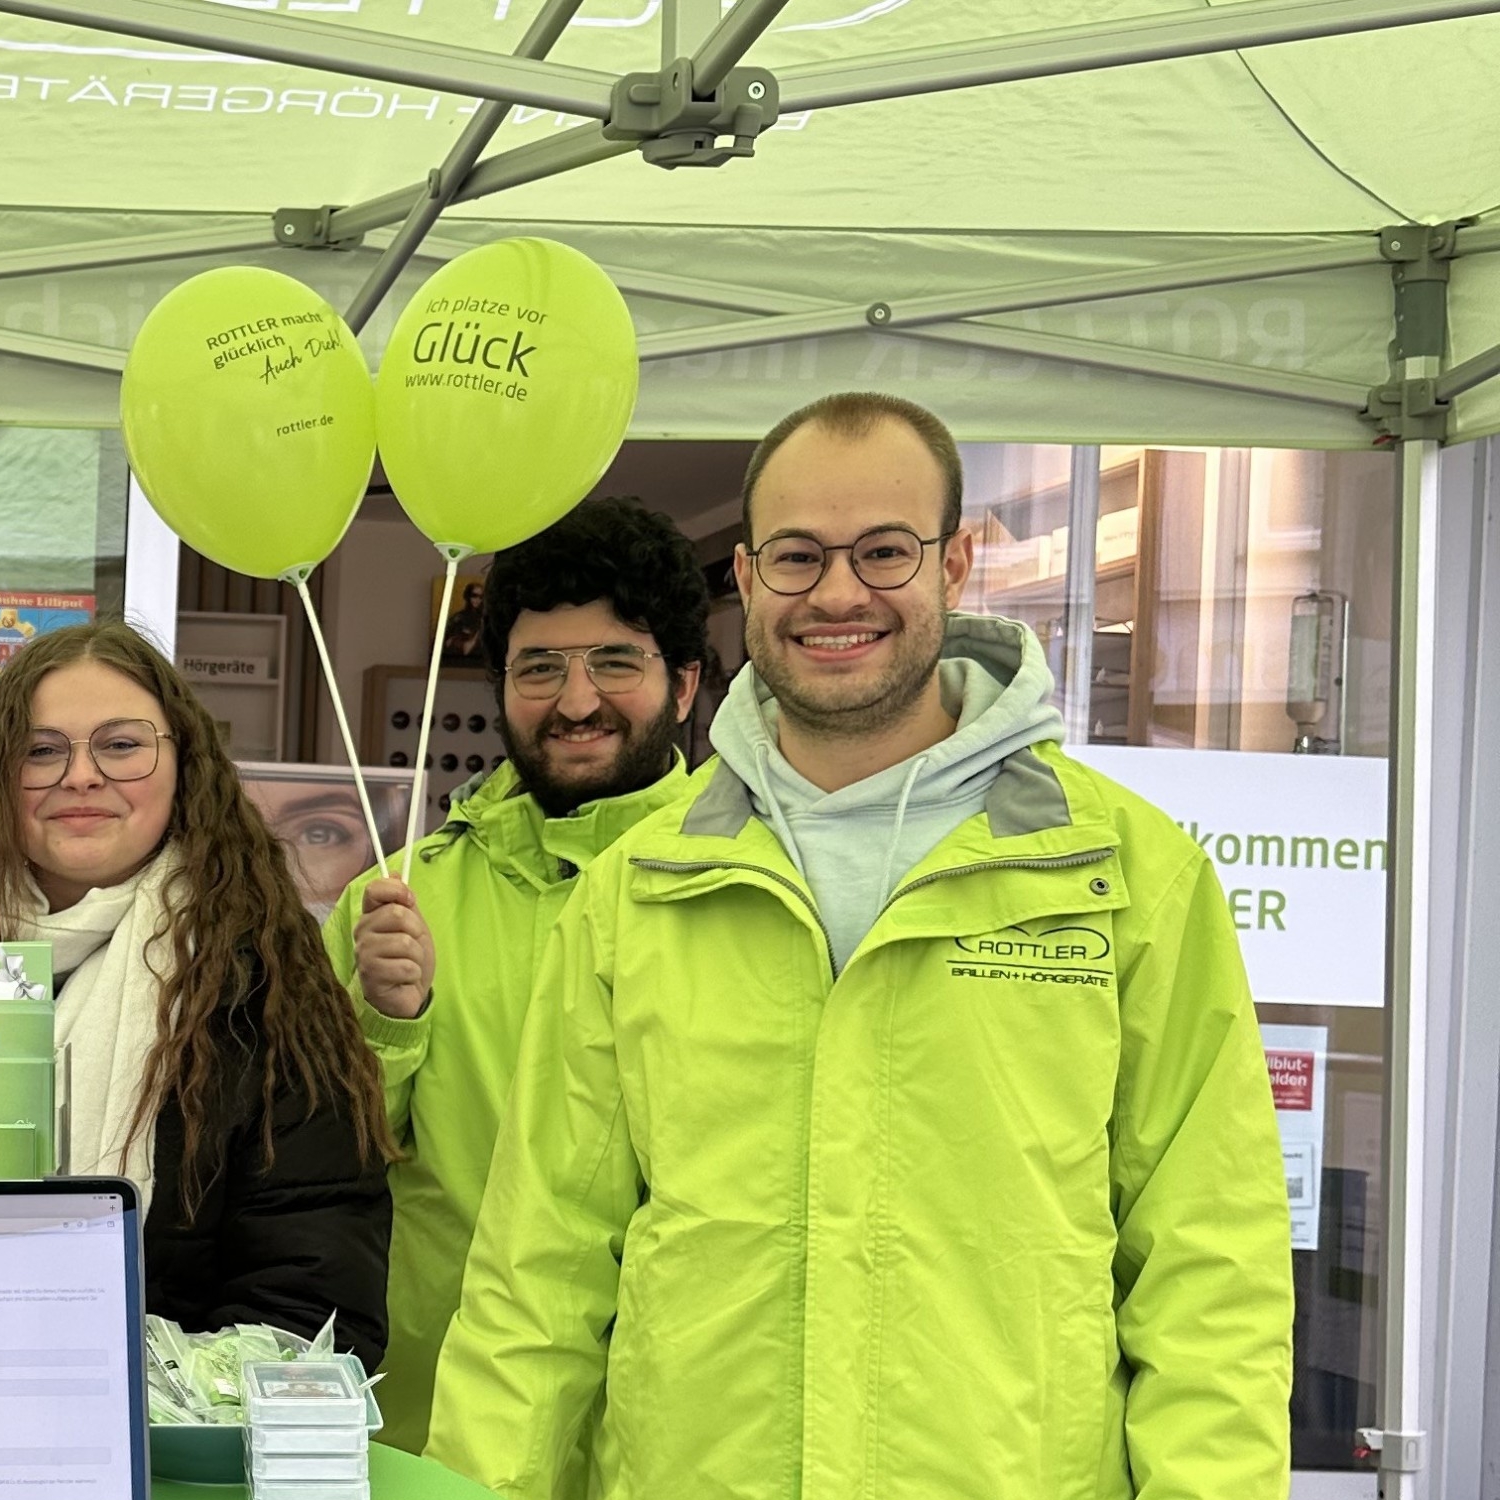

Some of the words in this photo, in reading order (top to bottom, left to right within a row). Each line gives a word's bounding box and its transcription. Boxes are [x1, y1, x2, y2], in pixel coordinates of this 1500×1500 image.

[426, 298, 449, 314] Ich
[451, 296, 510, 316] platze
[517, 306, 548, 325] vor
[206, 317, 279, 350] ROTTLER
[281, 312, 323, 327] macht
[213, 335, 286, 370] glücklich
[413, 321, 537, 378] Glück
[259, 345, 303, 385] Auch
[405, 373, 528, 402] www.rottler.de
[276, 415, 334, 437] rottler.de
[183, 658, 255, 676] Hörgeräte
[979, 940, 1087, 960] ROTTLER
[951, 967, 1010, 980] BRILLEN
[1022, 971, 1109, 987] HÖRGERÄTE
